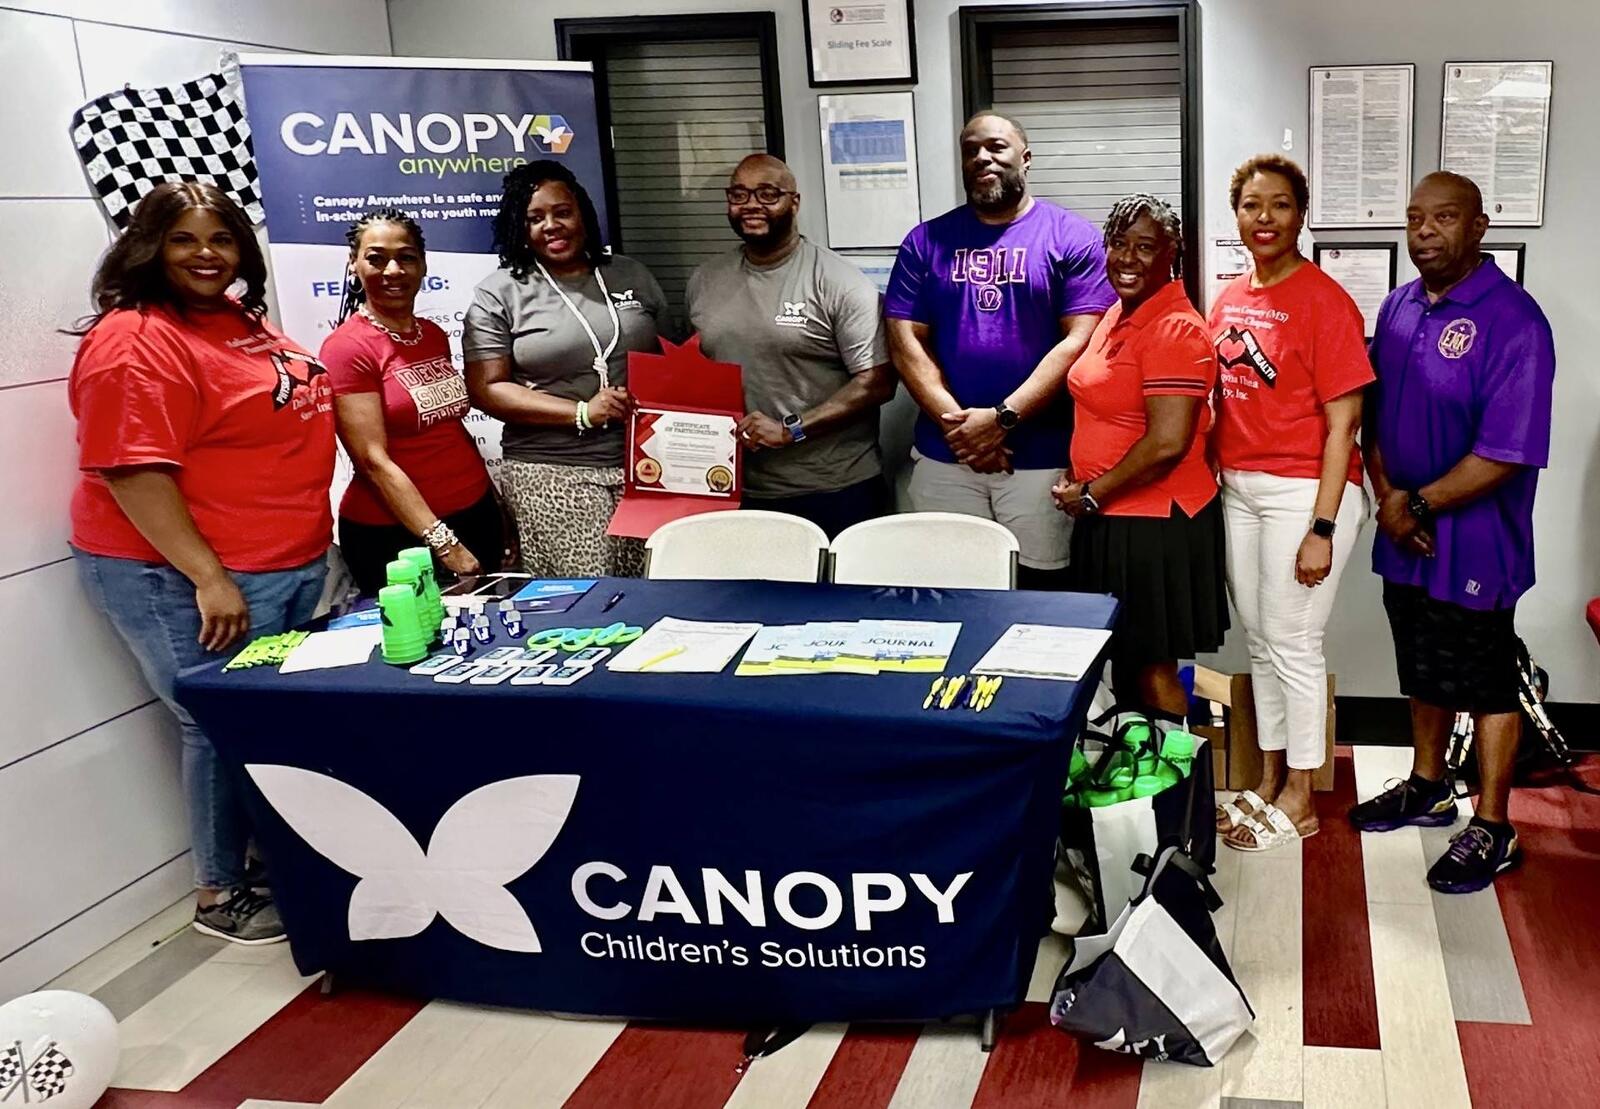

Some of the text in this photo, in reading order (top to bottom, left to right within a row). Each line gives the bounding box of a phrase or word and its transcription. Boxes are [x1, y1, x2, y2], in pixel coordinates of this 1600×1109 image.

[828, 39, 892, 50] Sliding Fee Scale
[280, 112, 533, 155] CANOPY
[313, 196, 365, 208] Canopy
[367, 194, 431, 207] Anywhere
[433, 193, 445, 203] is
[447, 195, 455, 203] a
[457, 193, 483, 203] safe
[315, 210, 368, 222] In-scho
[421, 208, 439, 218] for
[442, 208, 476, 220] youth
[952, 248, 1027, 285] 1911
[416, 377, 467, 409] SIGM
[803, 639, 845, 648] JOUR
[862, 637, 935, 648] JOURNAL
[571, 861, 974, 931] CANOPY
[580, 931, 927, 968] Children's Solutions
